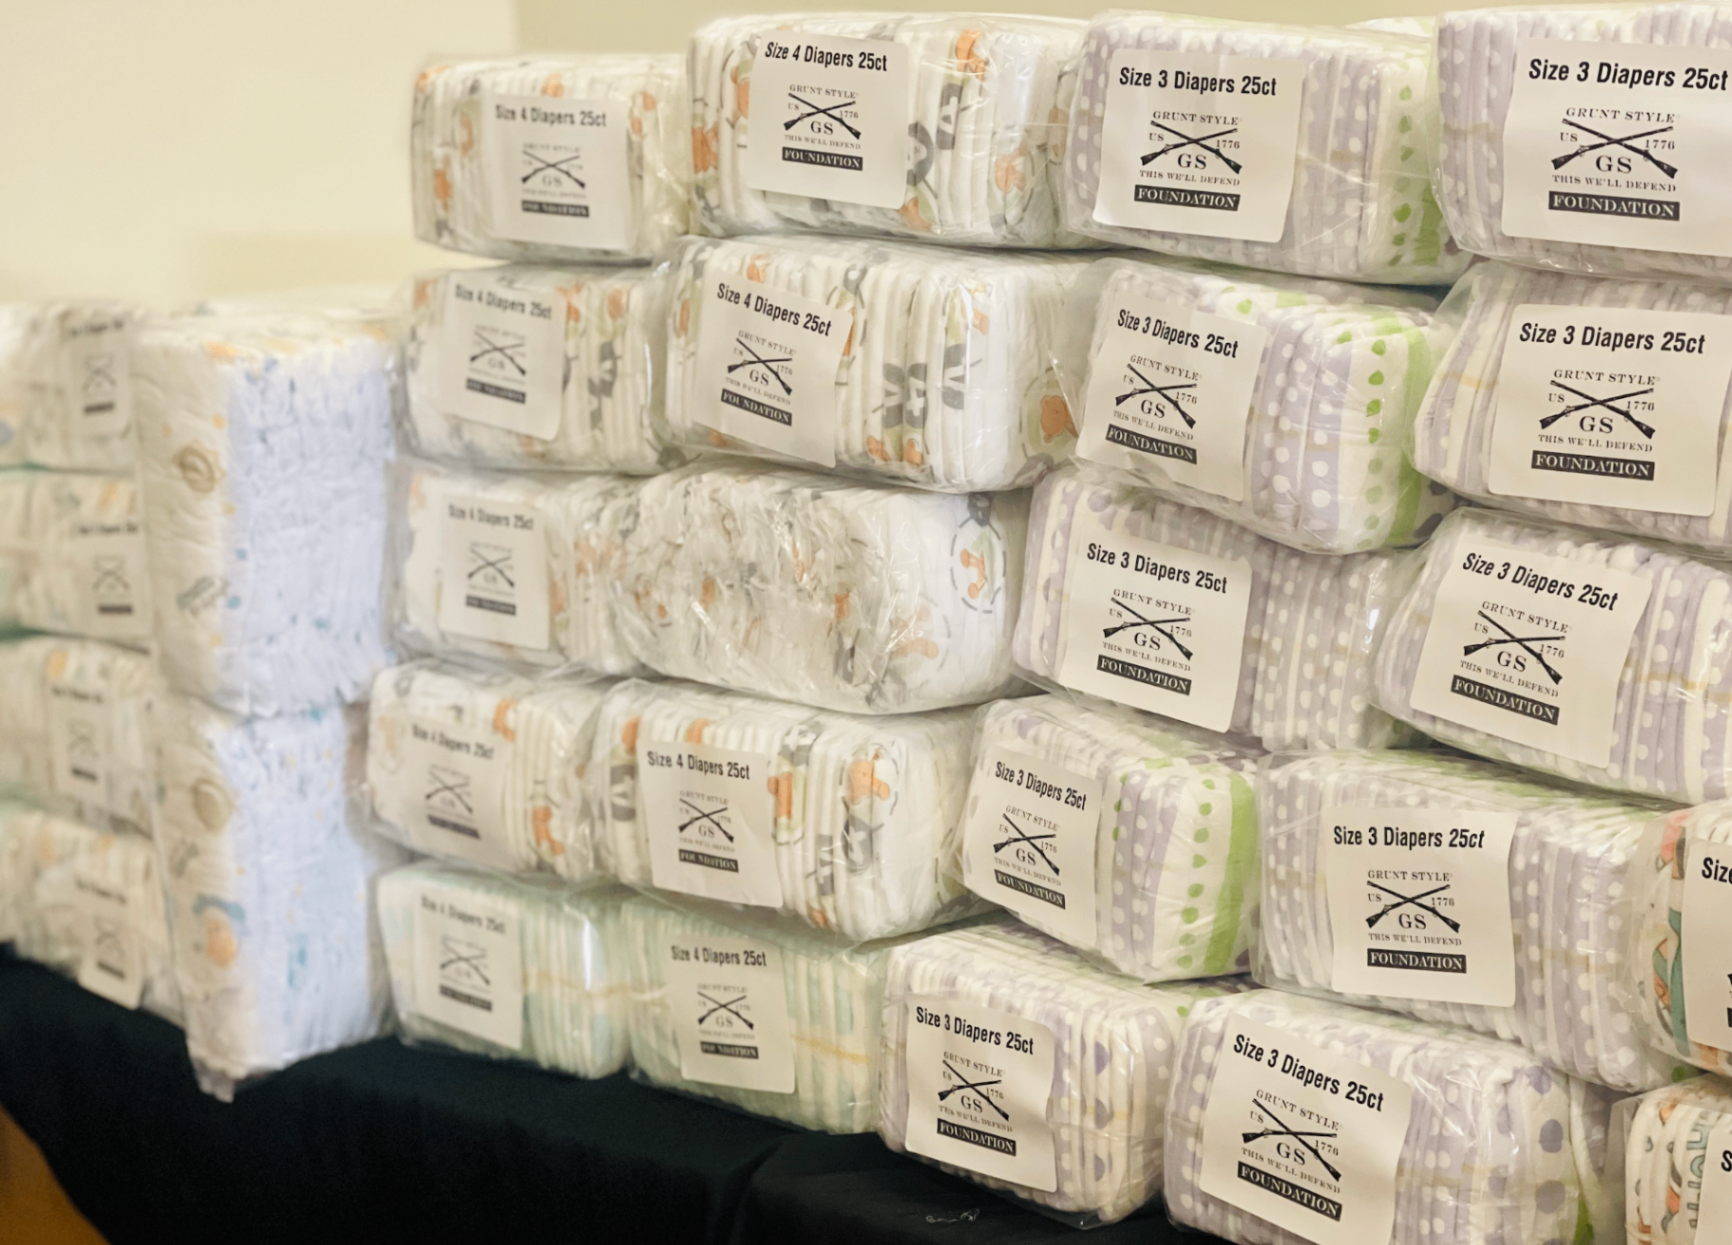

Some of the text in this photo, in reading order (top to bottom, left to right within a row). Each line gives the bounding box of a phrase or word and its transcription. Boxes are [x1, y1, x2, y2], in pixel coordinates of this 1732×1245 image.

[765, 42, 887, 71] Size 4 Diapers 25ct
[1119, 67, 1276, 96] Size 3 Diapers 25ct
[1529, 58, 1728, 91] Size 3 Diapers 25ct
[1153, 110, 1197, 122] GRUNT
[1566, 107, 1619, 120] GRUNT
[811, 120, 833, 135] GS
[1149, 133, 1164, 142] US
[1560, 132, 1578, 142] US
[784, 150, 860, 168] FOUNDATION
[1177, 153, 1207, 169] GS
[1596, 155, 1632, 173] GS
[1137, 187, 1236, 208] FOUNDATION
[1553, 195, 1675, 217] FOUNDATION
[717, 283, 831, 336] Size 4 Diapers 25ct
[1118, 309, 1238, 358] Size 3 Diapers 25ct
[1520, 323, 1705, 354] Size 3 Diapers 25ct
[750, 370, 769, 386] GS
[1554, 369, 1604, 381] GRUNT
[723, 391, 790, 423] FOUNDATION
[1548, 394, 1565, 402] US
[1140, 400, 1166, 419] GS
[1580, 416, 1613, 433] GS
[1108, 427, 1194, 460] FOUNDATION
[1536, 454, 1650, 476] FOUNDATION
[1087, 543, 1227, 594] Size 3 Diapers 25ct
[1463, 553, 1618, 611] Size 3 Diapers 25ct
[1113, 588, 1152, 605] GRUNT
[1109, 608, 1122, 618] US
[1482, 600, 1525, 620] GRUNT
[1474, 622, 1489, 634] US
[1134, 632, 1161, 651] GS
[1497, 650, 1526, 672] GS
[1100, 658, 1189, 692] FOUNDATION
[1454, 677, 1557, 721] FOUNDATION
[647, 751, 750, 779] Size 4 Diapers 25ct
[996, 762, 1086, 810] Size 3 Diapers 25ct
[698, 824, 714, 838] GS
[1334, 826, 1485, 850] Size 3 Diapers 25ct
[1016, 848, 1036, 866] GS
[1368, 870, 1408, 880] GRUNT
[998, 873, 1063, 905] FOUNDATION
[1368, 894, 1382, 902] US
[1399, 913, 1426, 929] GS
[671, 946, 766, 966] Size 4 Diapers 25ct
[1371, 952, 1462, 970] FOUNDATION
[716, 1016, 733, 1028] GS
[916, 1006, 1033, 1054] Size 3 Diapers 25ct
[1234, 1034, 1384, 1112] Size 3 Diapers 25ct
[961, 1095, 983, 1113] GS
[1256, 1089, 1296, 1113] GRUNT
[1250, 1111, 1264, 1123] US
[940, 1122, 1013, 1152] FOUNDATION
[1277, 1142, 1305, 1166] GS
[1241, 1165, 1338, 1216] FOUNDATION
